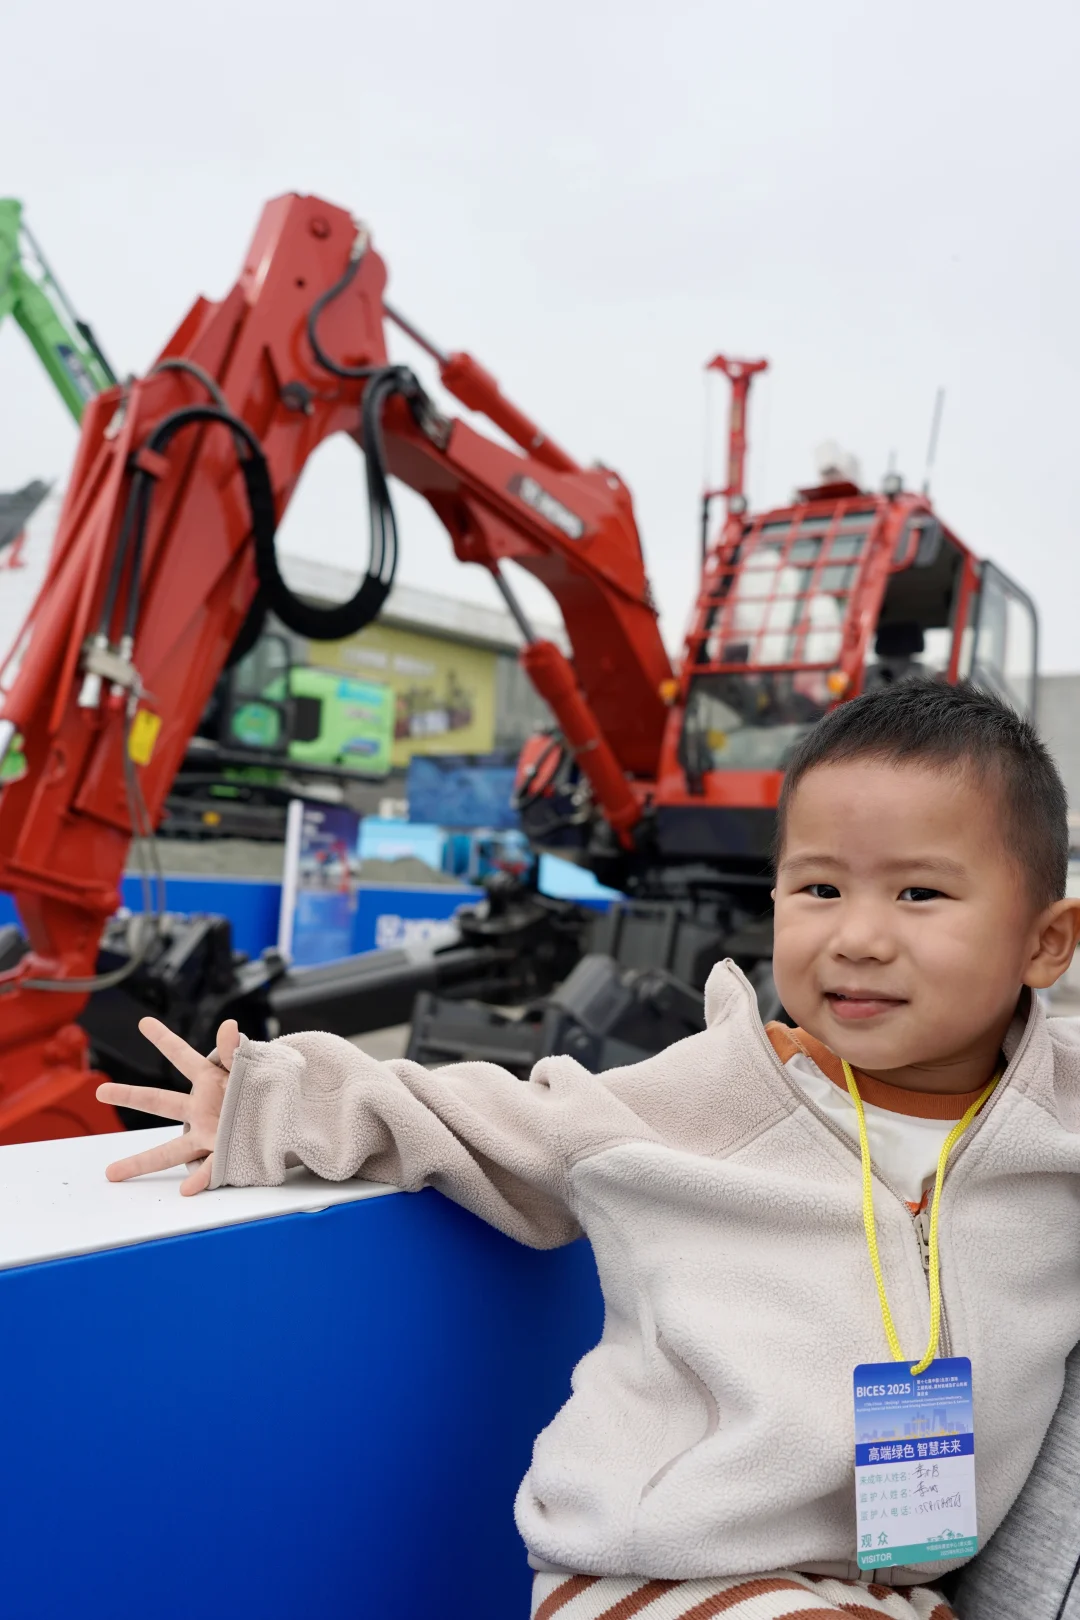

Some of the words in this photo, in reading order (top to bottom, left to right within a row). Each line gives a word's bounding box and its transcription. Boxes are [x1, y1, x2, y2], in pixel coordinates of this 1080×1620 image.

[856, 1385, 886, 1398] BICES
[887, 1383, 911, 1395] 2025
[868, 1444, 915, 1462] 高端绿色
[917, 1439, 961, 1457] 智慧未来
[861, 1552, 892, 1564] VISITOR
